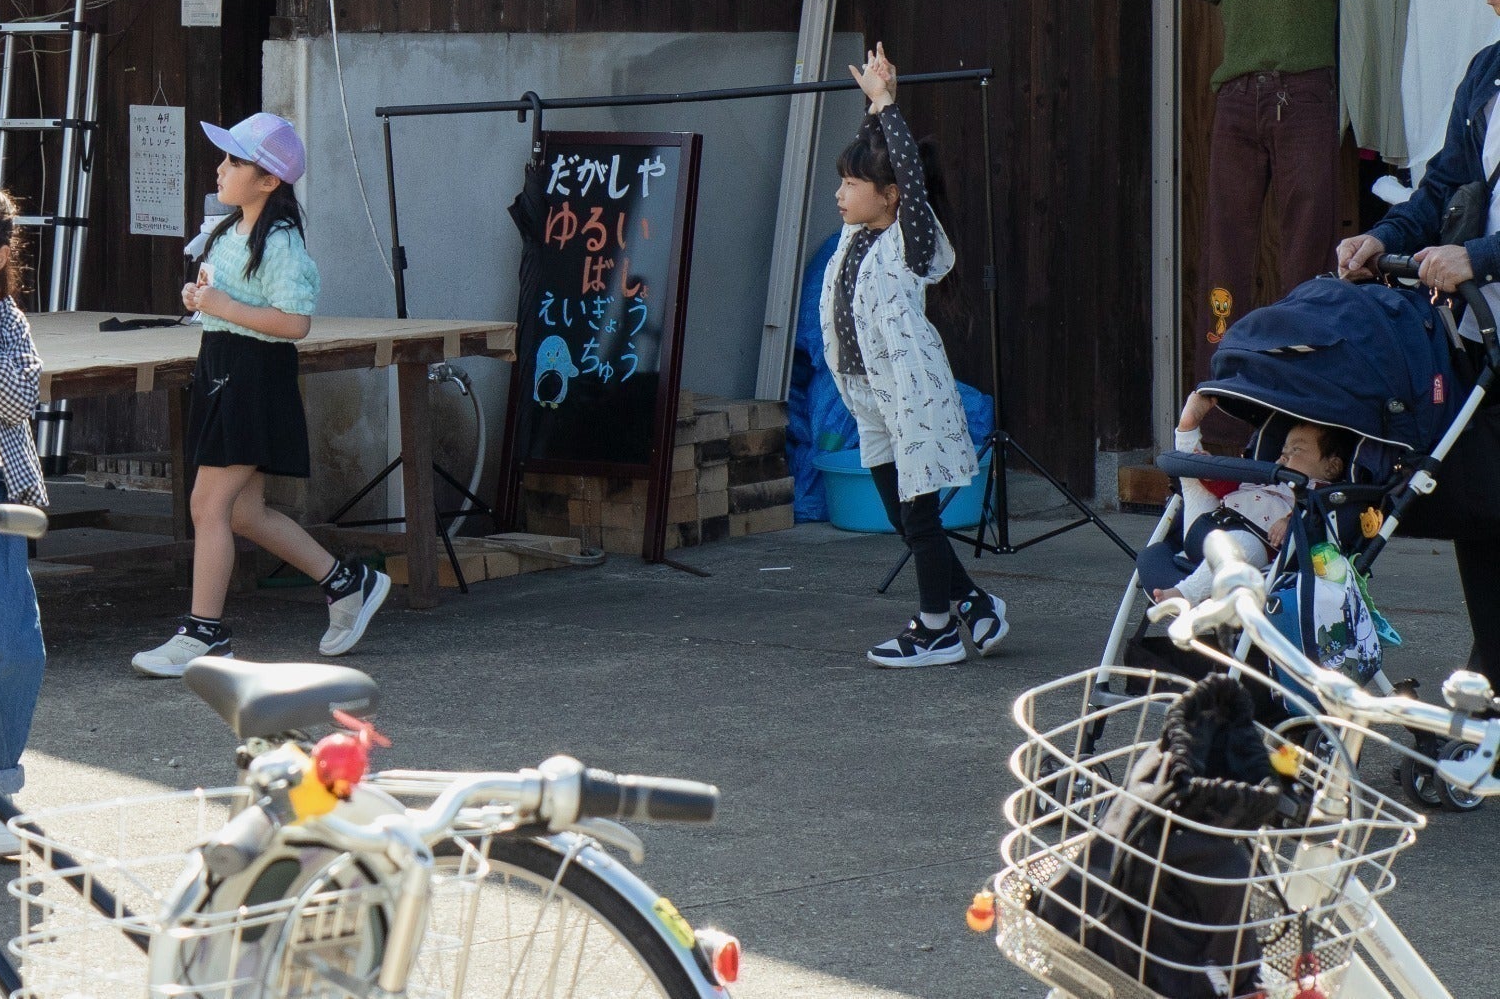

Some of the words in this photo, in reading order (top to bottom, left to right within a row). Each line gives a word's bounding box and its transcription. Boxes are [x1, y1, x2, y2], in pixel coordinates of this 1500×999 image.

[546, 153, 666, 198] だがしや
[545, 201, 650, 252] ゆるい
[581, 255, 649, 299] ばしょ
[538, 291, 648, 337] えいぎょう
[580, 336, 639, 384] ちゅう
